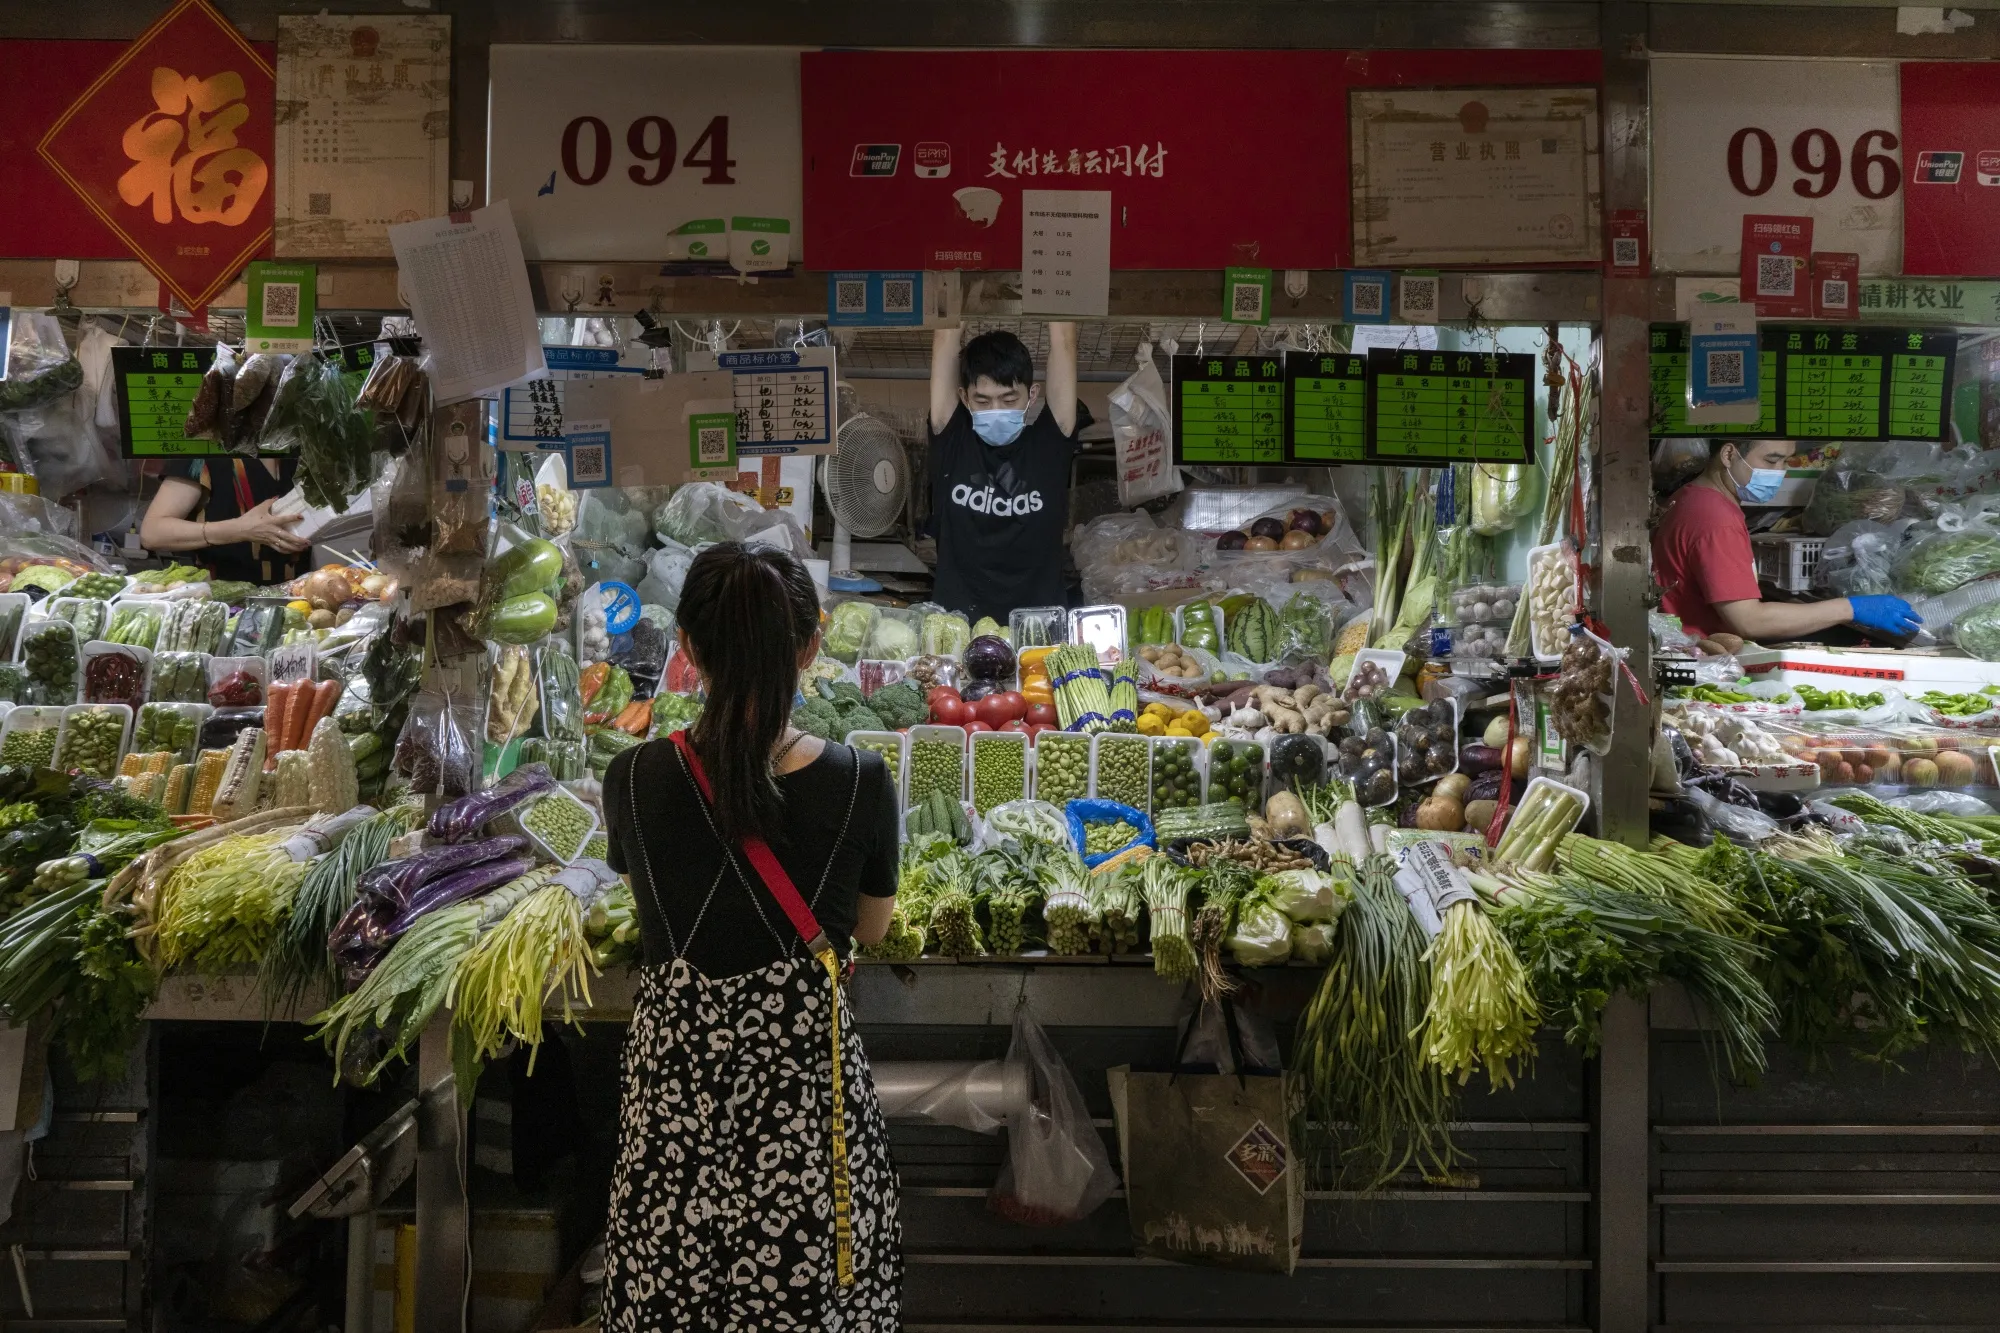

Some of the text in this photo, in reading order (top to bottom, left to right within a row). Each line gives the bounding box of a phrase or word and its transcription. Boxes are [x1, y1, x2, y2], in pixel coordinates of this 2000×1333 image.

[319, 63, 410, 84] 营业执照
[118, 66, 268, 227] 福
[561, 115, 736, 187] 094
[917, 148, 948, 158] 云闪付
[1429, 141, 1521, 162] 营业执照
[857, 152, 896, 164] UnionPay
[983, 141, 1168, 178] 支付先看云闪付
[1727, 127, 1901, 199] 096
[871, 162, 892, 170] 银联
[1920, 160, 1959, 172] UnionPay
[1935, 169, 1956, 177] 银联
[1753, 223, 1801, 235] 扫码领红包
[935, 250, 982, 261] 扫码领红包
[1787, 334, 1858, 350] 品价签
[1907, 333, 1924, 350] 签
[725, 352, 793, 366] 商品标价签
[1320, 357, 1363, 375] 商品
[1403, 354, 1500, 374] 商品价签
[1808, 358, 1871, 368] 单位 售价
[1908, 357, 1935, 367] 售价
[1207, 361, 1278, 377] 商品价
[147, 376, 184, 386] 品名
[1312, 381, 1347, 391] 品名
[1395, 377, 1429, 388] 品名
[1452, 379, 1471, 389] 单位
[1200, 384, 1277, 394] 品名 单位
[951, 484, 1044, 517] adidas
[1240, 1143, 1277, 1163] 多彩
